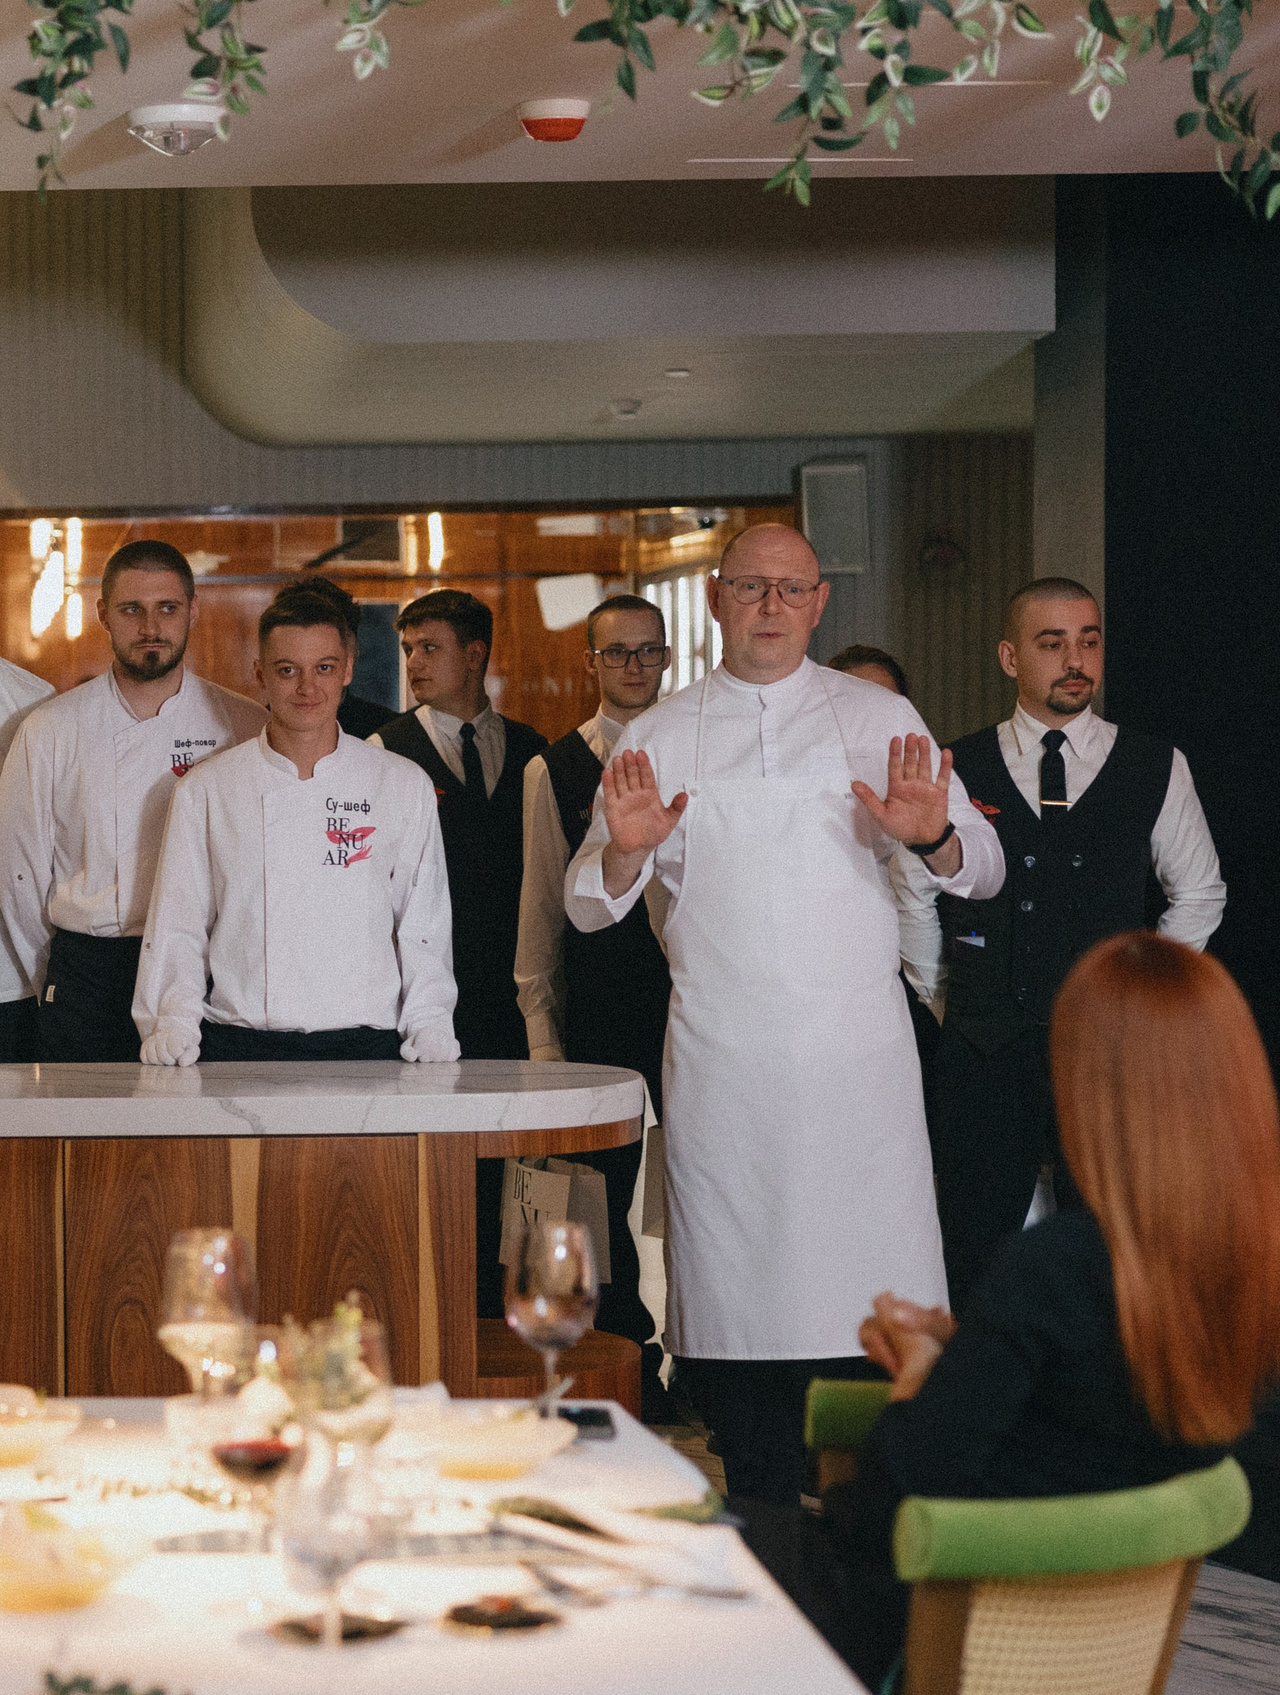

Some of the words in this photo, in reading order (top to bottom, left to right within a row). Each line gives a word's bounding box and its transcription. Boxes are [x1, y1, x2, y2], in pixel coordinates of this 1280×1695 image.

[170, 752, 195, 768] BE
[325, 797, 371, 815] Су-шеф
[326, 817, 351, 834] BE
[336, 833, 364, 850] NU
[322, 849, 350, 866] AR
[514, 1166, 532, 1205] BE
